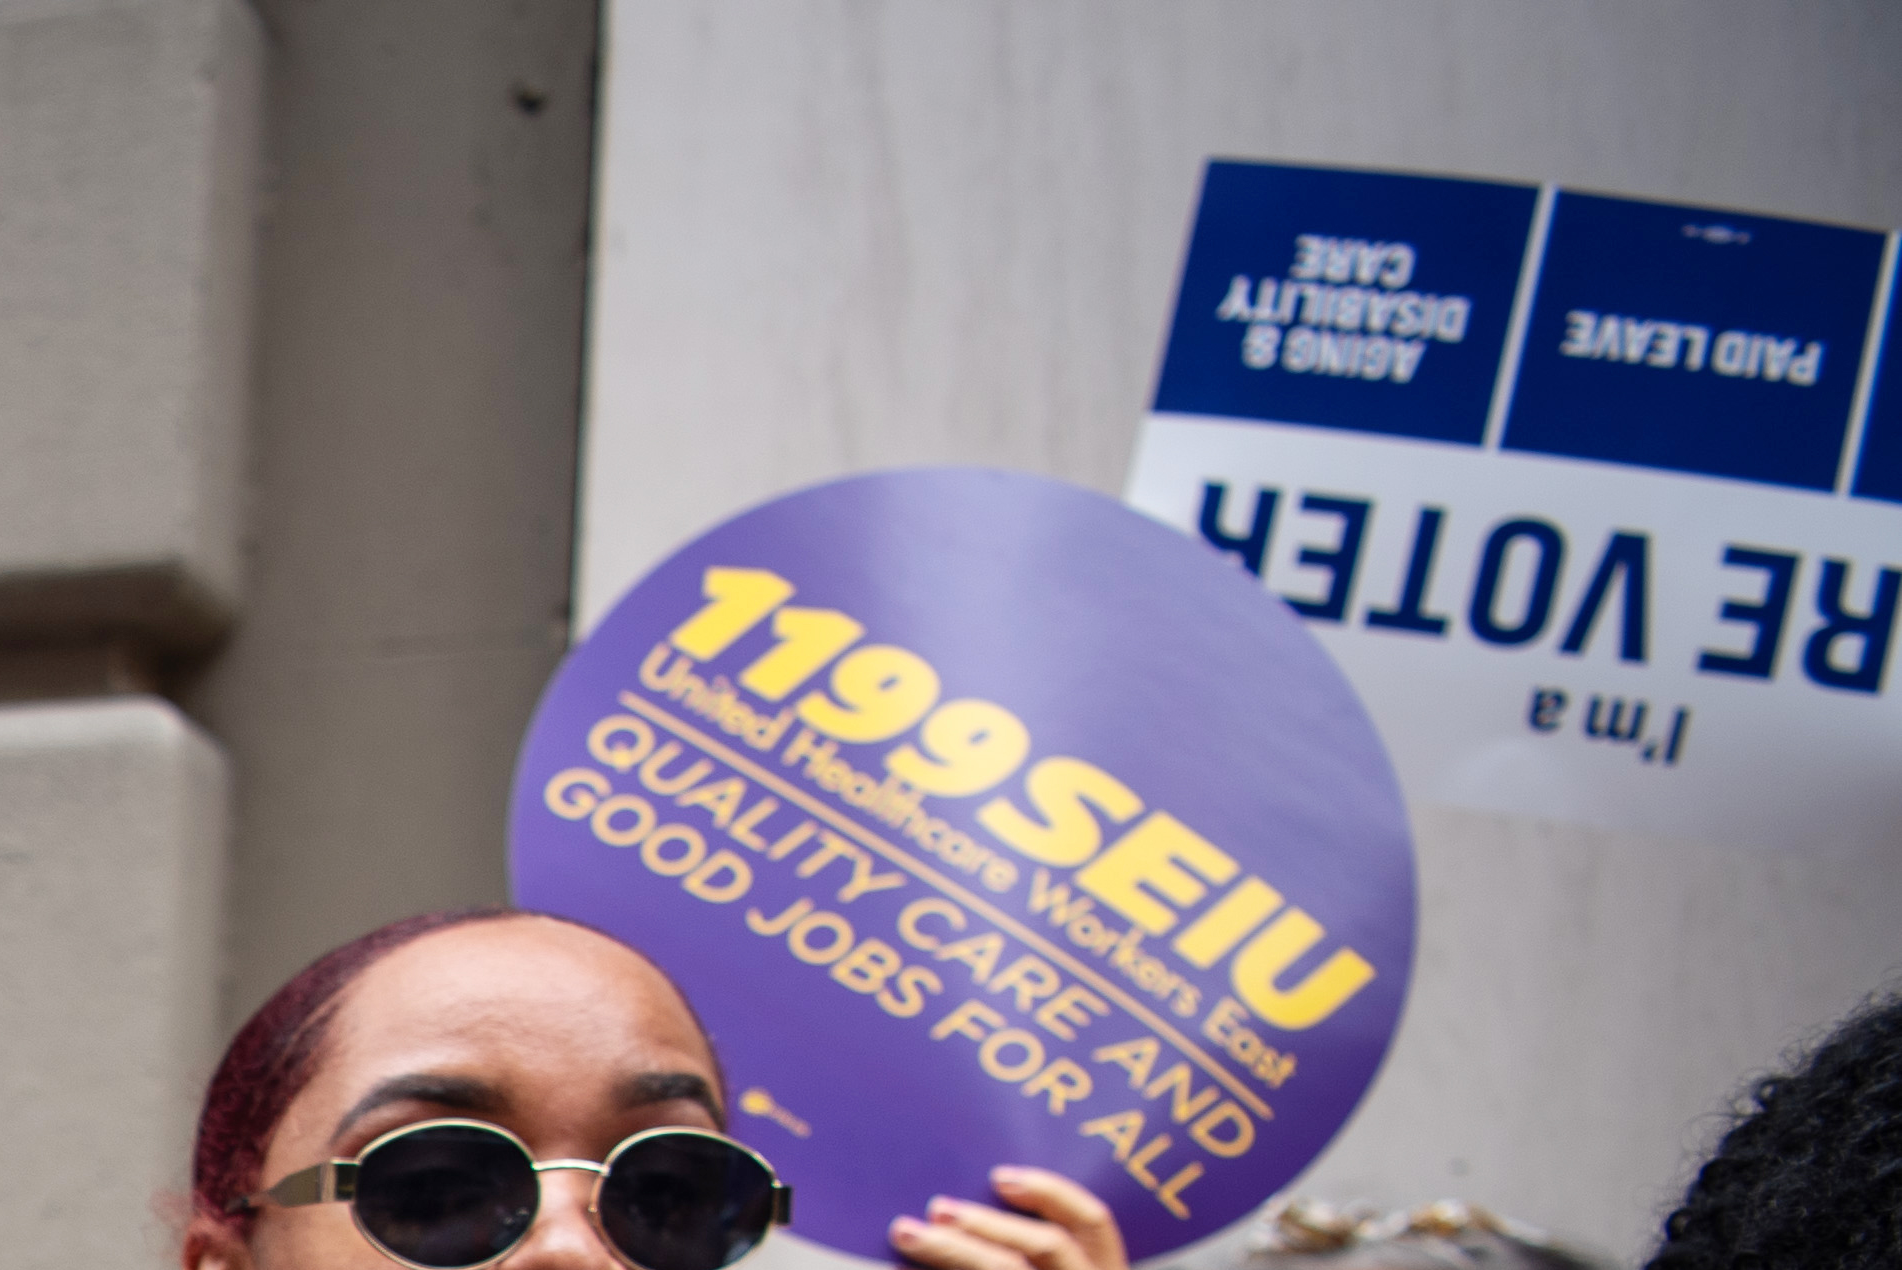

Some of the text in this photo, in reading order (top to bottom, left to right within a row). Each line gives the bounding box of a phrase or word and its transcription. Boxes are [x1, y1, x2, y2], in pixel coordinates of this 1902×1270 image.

[1216, 275, 1471, 342] DISABILITY
[1291, 234, 1416, 289] CARE
[1242, 324, 1427, 382] AGING &
[1560, 311, 1823, 386] PAID LEAVE
[1199, 481, 1653, 662] VOTER
[1528, 688, 1691, 766] I'm a
[668, 566, 1376, 1031] 1199SEIU
[638, 643, 1298, 1090] United Healthcare Workers East
[543, 766, 755, 905] GOOD
[744, 893, 944, 1018] JOBS
[929, 1001, 1095, 1114] FOR
[1081, 1108, 1215, 1221] ALL
[586, 711, 1257, 1160] QUALITY CARE AND
